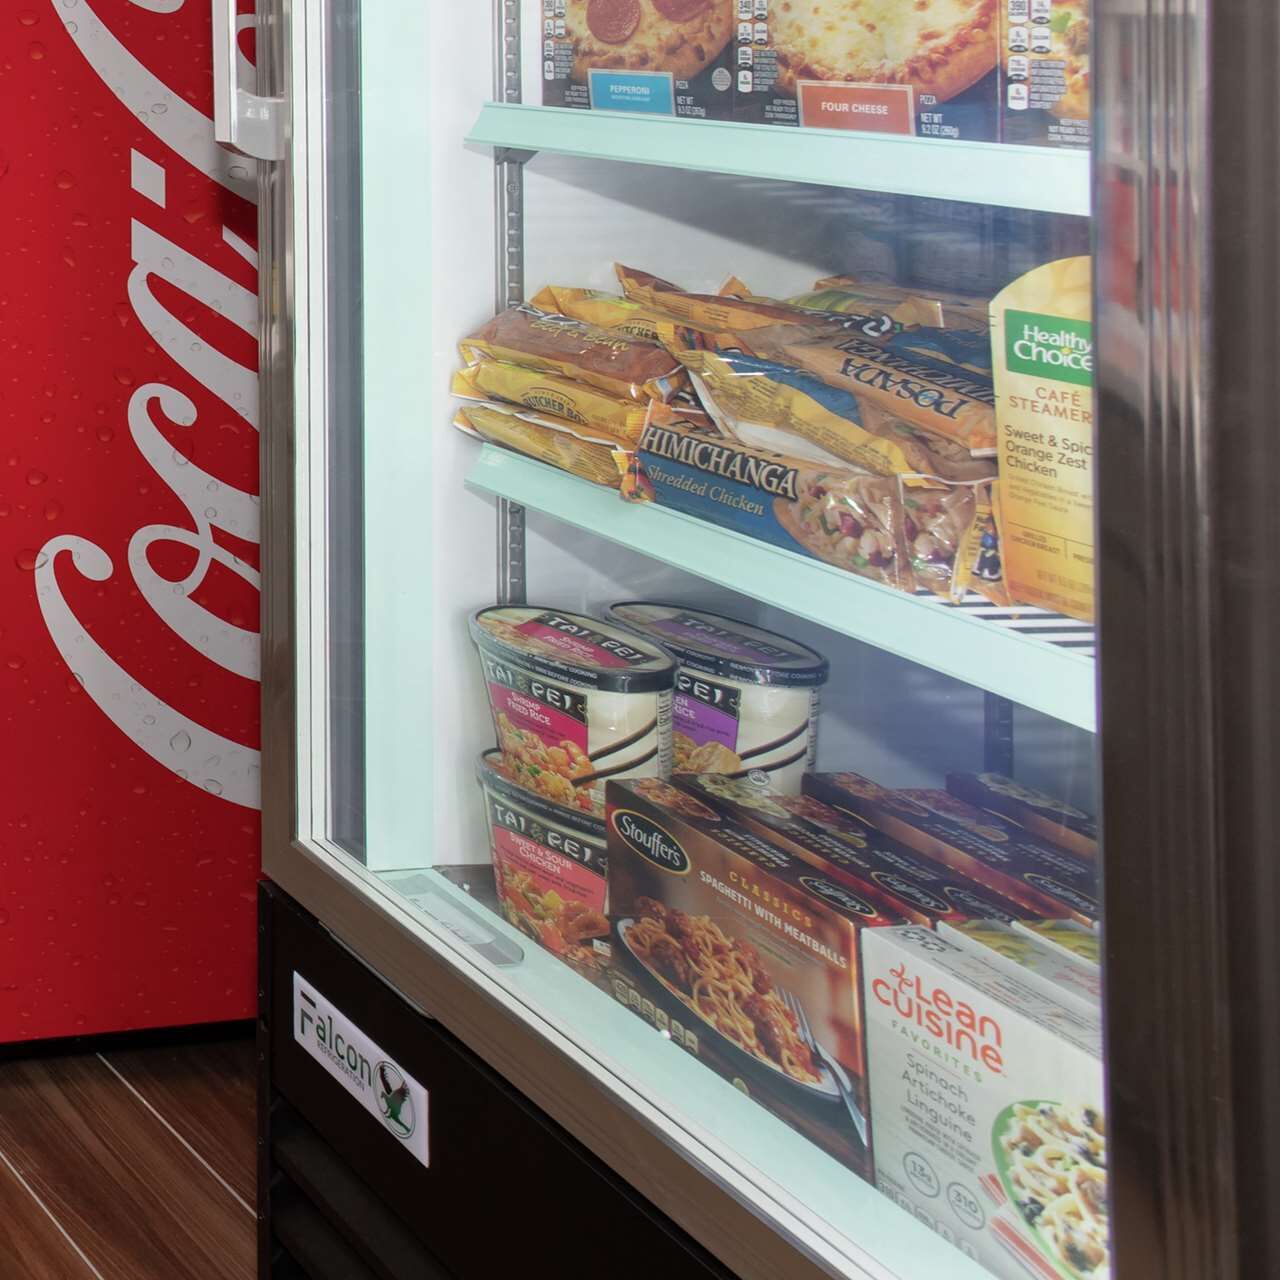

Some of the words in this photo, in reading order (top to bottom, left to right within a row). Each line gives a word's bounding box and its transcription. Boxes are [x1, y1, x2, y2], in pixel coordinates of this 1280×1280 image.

[610, 84, 650, 96] PEPPERONI
[821, 101, 849, 113] FOUR
[851, 103, 888, 115] CHEESE
[920, 94, 937, 105] PIZZA
[920, 113, 933, 123] NET
[1013, 340, 1093, 372] Choice
[1023, 324, 1092, 353] Healthy
[840, 357, 970, 419] POSADA
[1034, 385, 1082, 408] CAFÉ
[1004, 424, 1045, 446] Sweet
[1047, 434, 1058, 448] &
[1005, 440, 1054, 463] Orange
[1056, 451, 1088, 471] Zest
[646, 464, 708, 497] Shredded
[709, 486, 765, 516] Chicken
[1006, 455, 1058, 479] Chicken
[548, 615, 590, 637] TAI
[600, 639, 644, 661] PEI
[487, 660, 513, 685] TAI
[530, 681, 572, 710] PEI
[529, 710, 552, 726] RICE
[494, 804, 526, 830] TAI
[547, 831, 592, 862] PEI
[510, 832, 537, 853] SWEET
[544, 849, 573, 871] SOUR
[620, 814, 681, 867] Stouffer's
[519, 847, 561, 875] CHICKEN
[699, 870, 752, 911] SPAGHETTI
[754, 903, 782, 929] WITH
[784, 922, 847, 969] MEATBALLS
[729, 871, 813, 928] CLASSICS
[914, 975, 1003, 1048] Lean
[300, 990, 372, 1087] Falcon
[891, 1020, 983, 1084] FAVORITES
[316, 1040, 366, 1093] REFRIGERATION
[905, 1053, 969, 1102] Spinach
[901, 1071, 976, 1127] Artichoke
[906, 1090, 973, 1144] Linguine
[953, 1190, 978, 1215] 310
